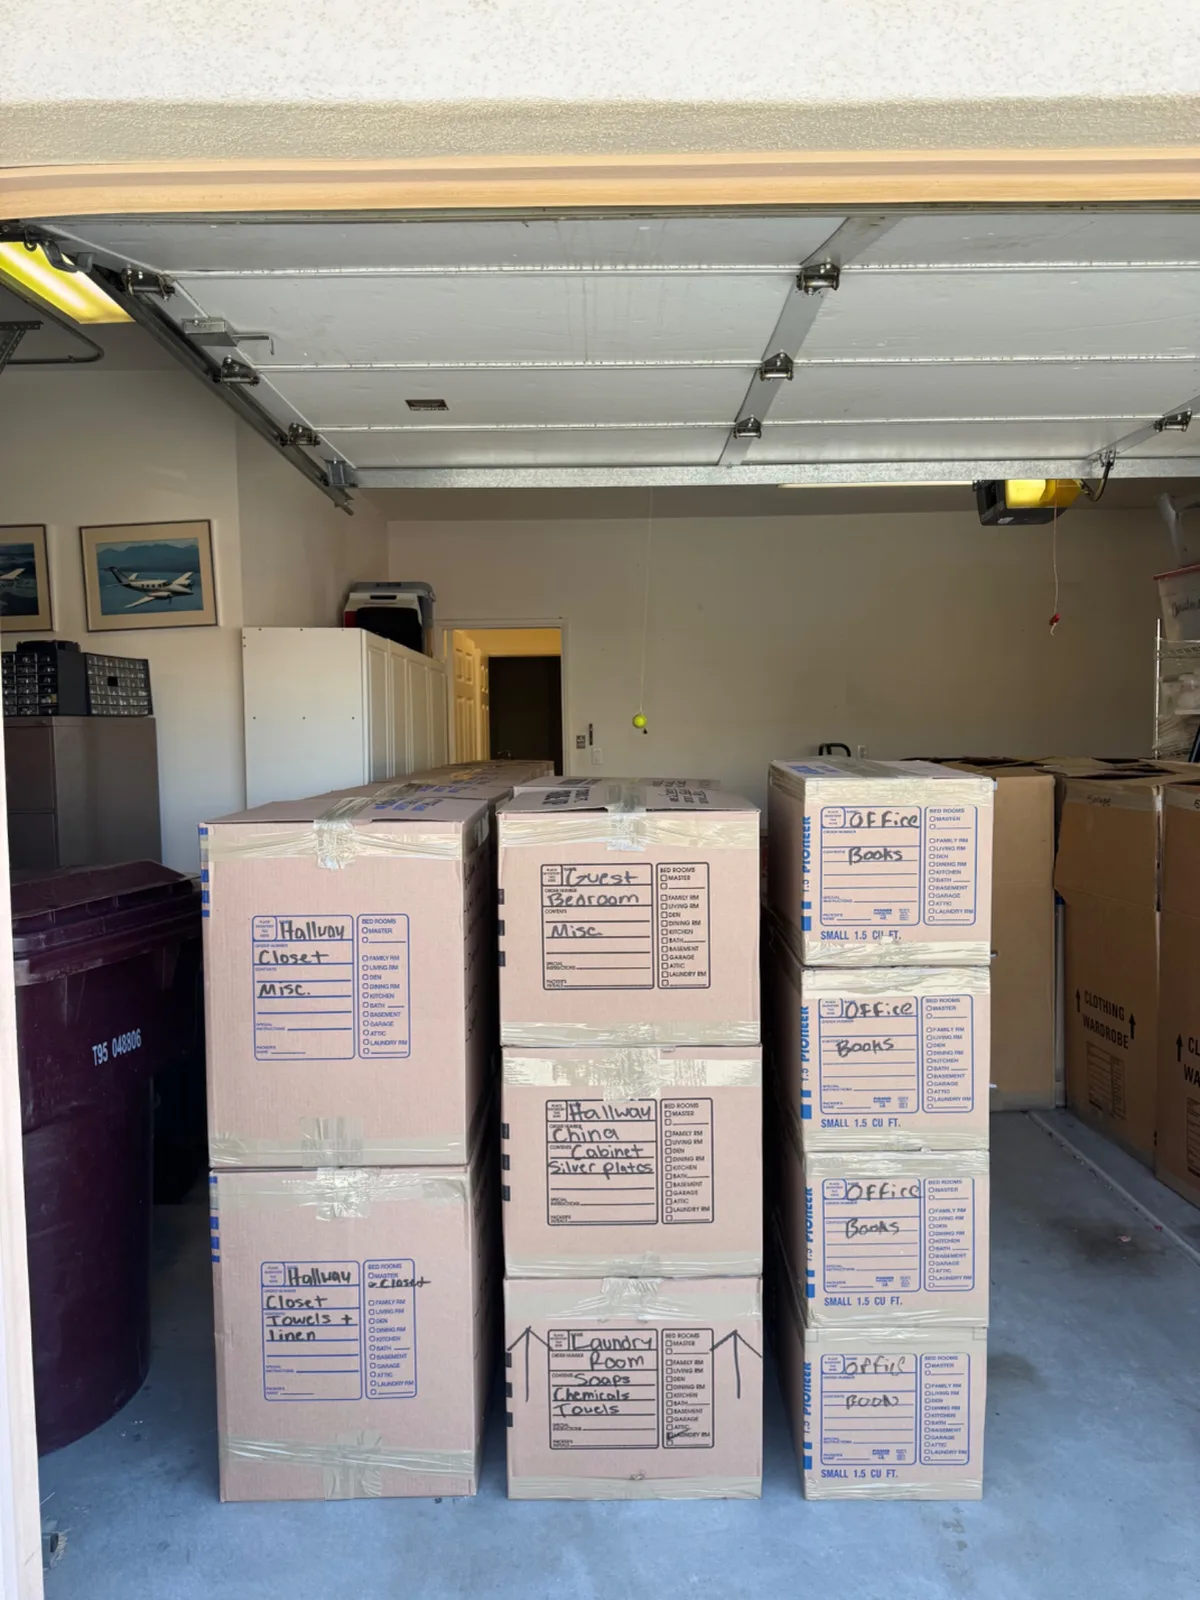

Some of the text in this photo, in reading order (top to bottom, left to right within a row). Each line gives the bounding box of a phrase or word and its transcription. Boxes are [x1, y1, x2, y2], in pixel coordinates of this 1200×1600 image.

[849, 847, 902, 865] Books
[566, 868, 638, 886] Guest
[280, 920, 344, 941] Hallway
[821, 931, 849, 940] SMALL
[854, 931, 867, 939] 1.5
[259, 950, 329, 964] Closet
[260, 982, 310, 997] Misc.
[1084, 990, 1125, 1021] CLOTHING
[1082, 1014, 1129, 1049] WARDROBE
[92, 1042, 108, 1066] T95
[836, 1038, 894, 1057] Books
[569, 1102, 651, 1121] Hallway
[821, 1119, 900, 1127] SMALL 1.5 CU FT.
[553, 1127, 619, 1142] China
[571, 1144, 643, 1160] Cabinet
[549, 1161, 596, 1174] Silver
[846, 1218, 899, 1239] Books
[288, 1268, 351, 1286] Hallway
[266, 1295, 327, 1309] Closet
[824, 1297, 902, 1306] SMALL 1.5 CU FT.
[266, 1313, 331, 1326] Towels
[571, 1334, 652, 1351] Laundry
[590, 1351, 644, 1371] Room
[575, 1373, 630, 1386] Soaps
[553, 1387, 630, 1401] Chemicals
[553, 1403, 619, 1417] Towels
[821, 1469, 898, 1477] SMALL 1.5 CU FT.
